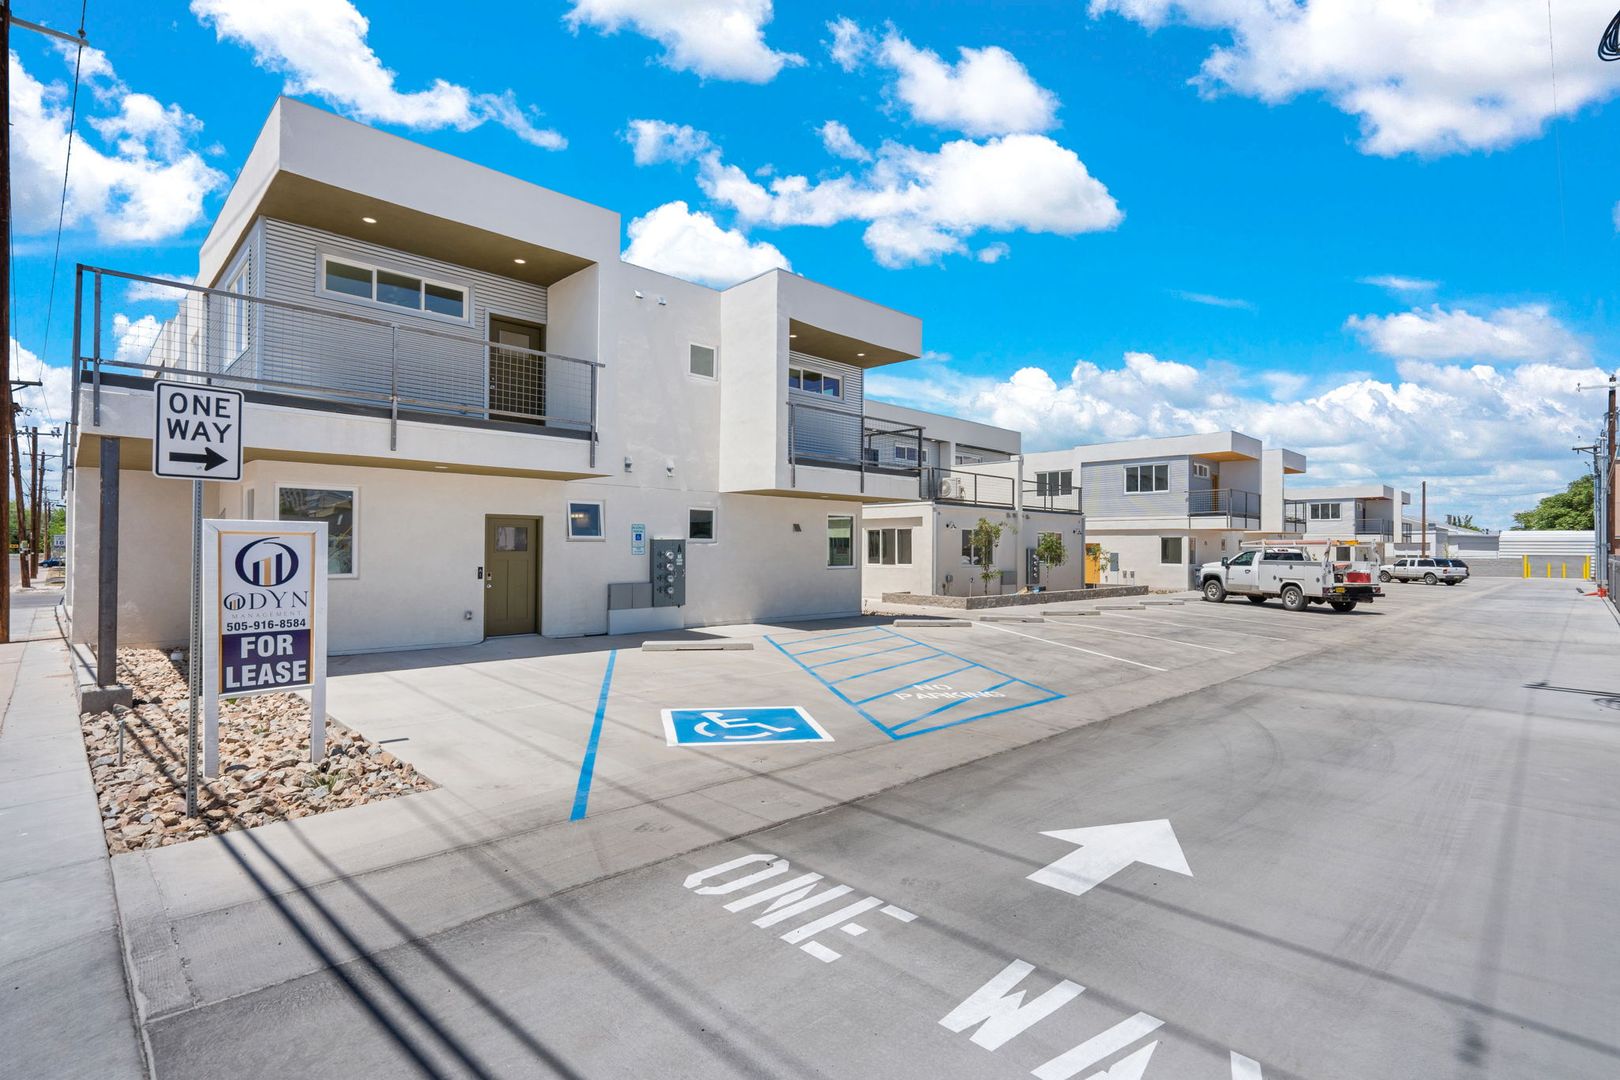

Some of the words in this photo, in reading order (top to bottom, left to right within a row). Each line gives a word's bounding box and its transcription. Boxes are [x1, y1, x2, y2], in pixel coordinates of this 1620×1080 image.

[169, 392, 231, 419] ONE
[166, 417, 232, 443] WAY
[223, 589, 309, 611] ODYN
[226, 618, 306, 632] 505-916-8584
[231, 611, 301, 619] MANAGEMENT
[241, 634, 294, 659] FOR
[226, 660, 307, 689] LEASE
[682, 853, 919, 963] ONE
[937, 958, 1263, 1080] WA
